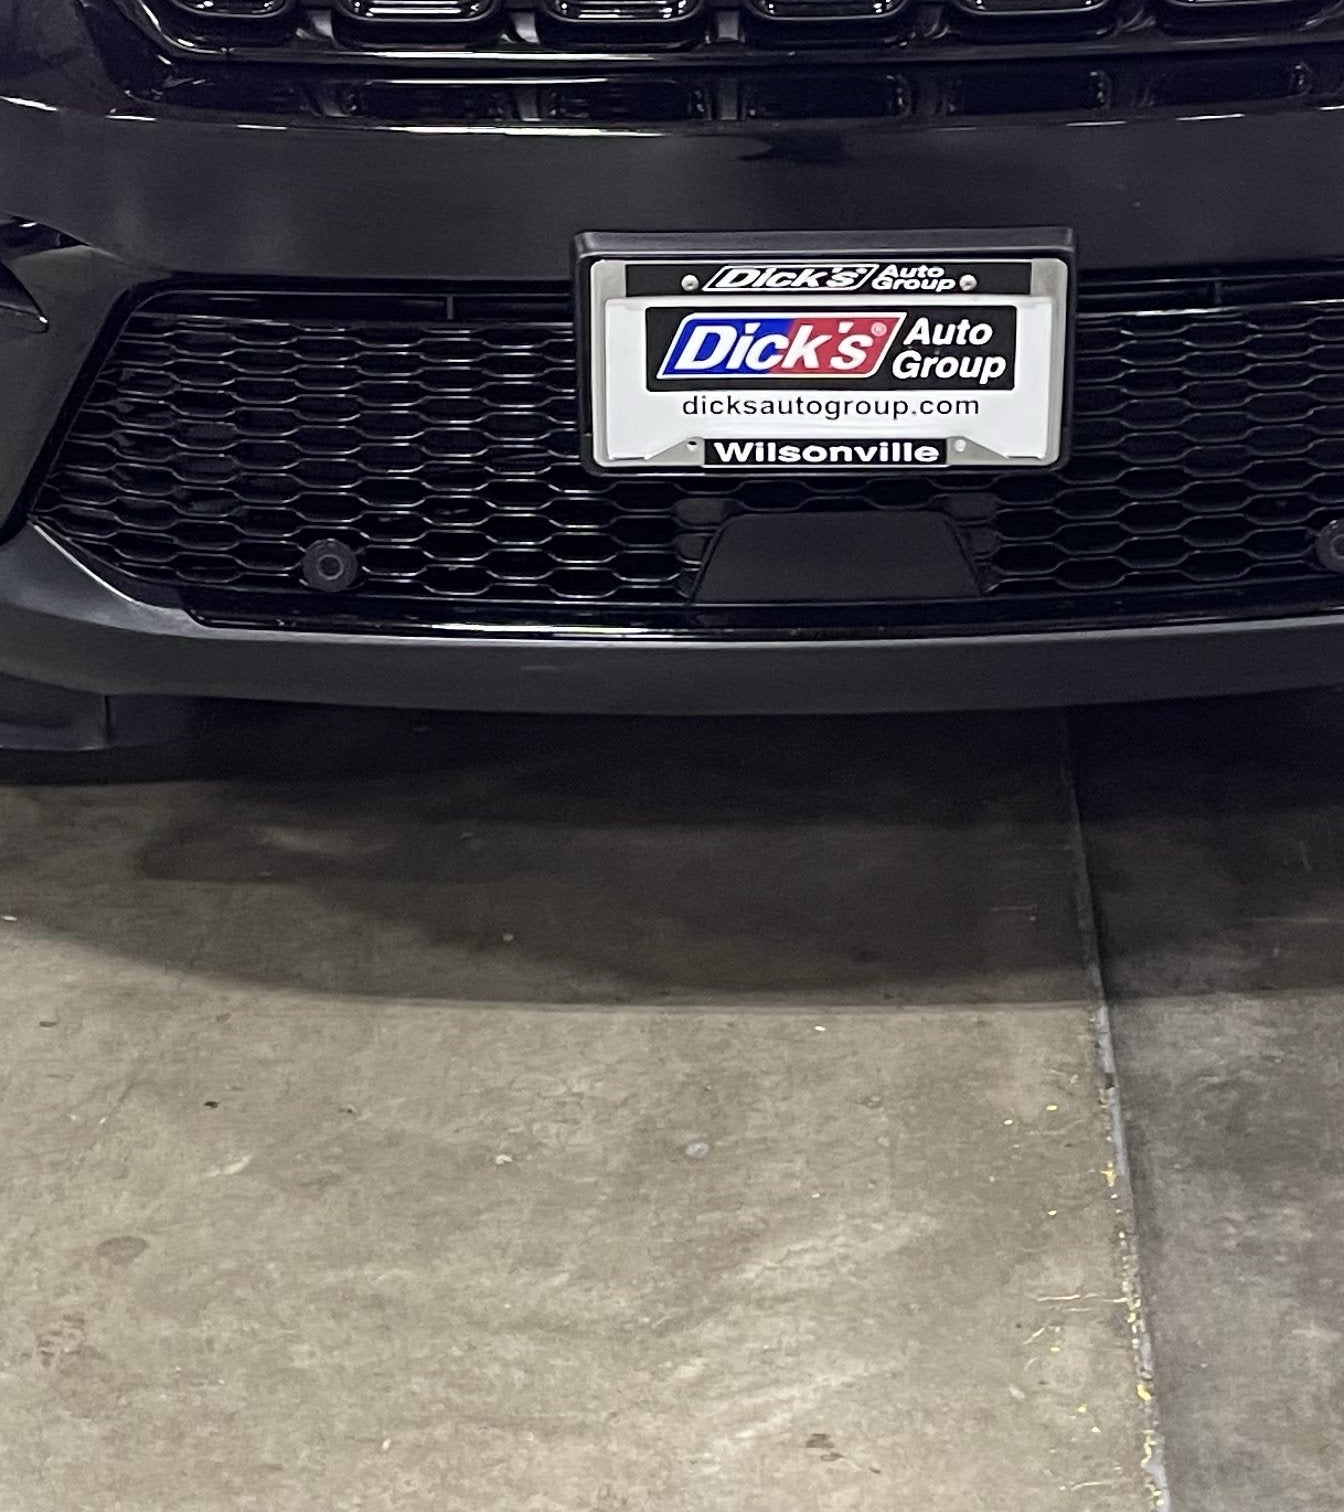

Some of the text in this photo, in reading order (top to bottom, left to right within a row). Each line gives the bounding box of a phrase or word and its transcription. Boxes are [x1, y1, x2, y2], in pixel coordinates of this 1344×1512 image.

[884, 264, 944, 279] Auto
[871, 277, 956, 292] Group
[905, 317, 993, 346] Auto
[892, 350, 1006, 384] Group
[682, 395, 979, 420] dicksautogroup.com
[712, 441, 940, 463] Wilsonville
